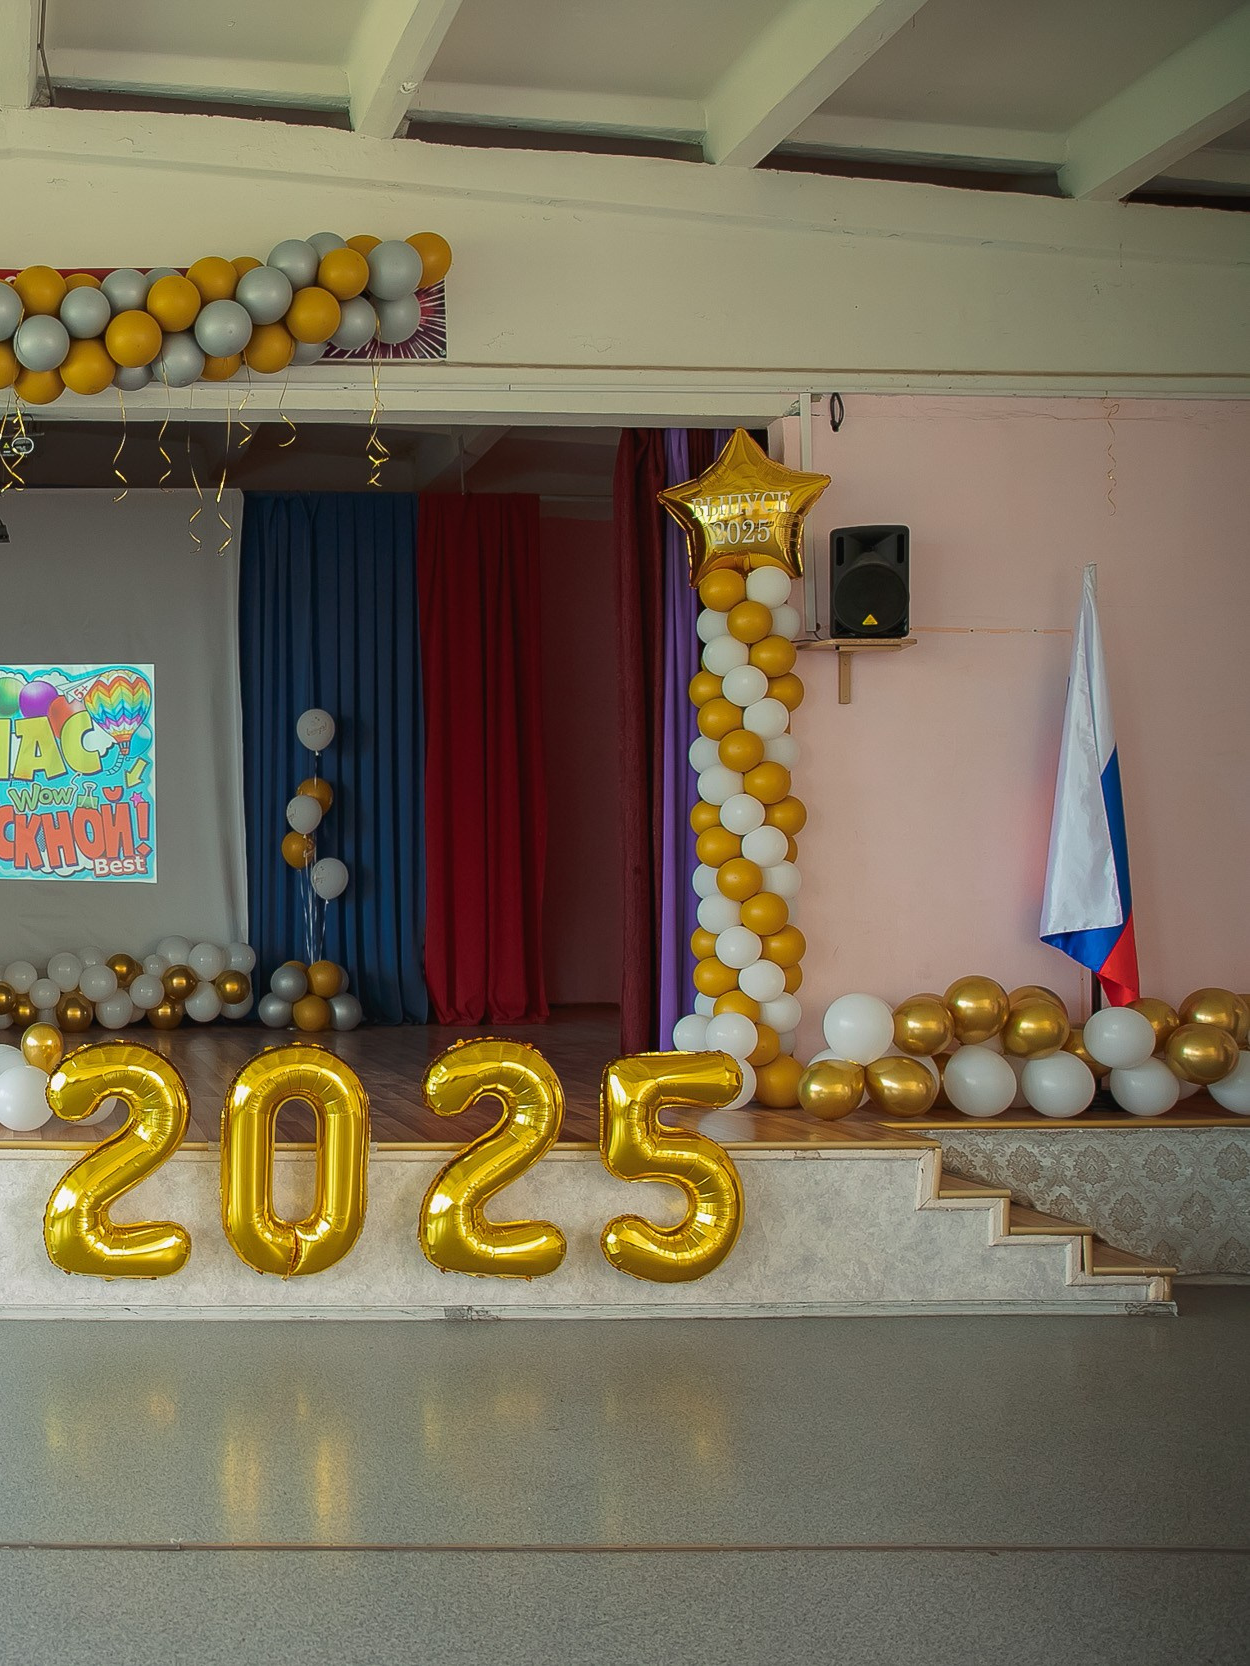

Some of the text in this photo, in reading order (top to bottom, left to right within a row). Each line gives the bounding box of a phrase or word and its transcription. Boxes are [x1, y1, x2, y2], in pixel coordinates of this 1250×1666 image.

[711, 519, 771, 545] 2025
[93, 857, 149, 877] Best
[44, 1038, 745, 1283] 2025
